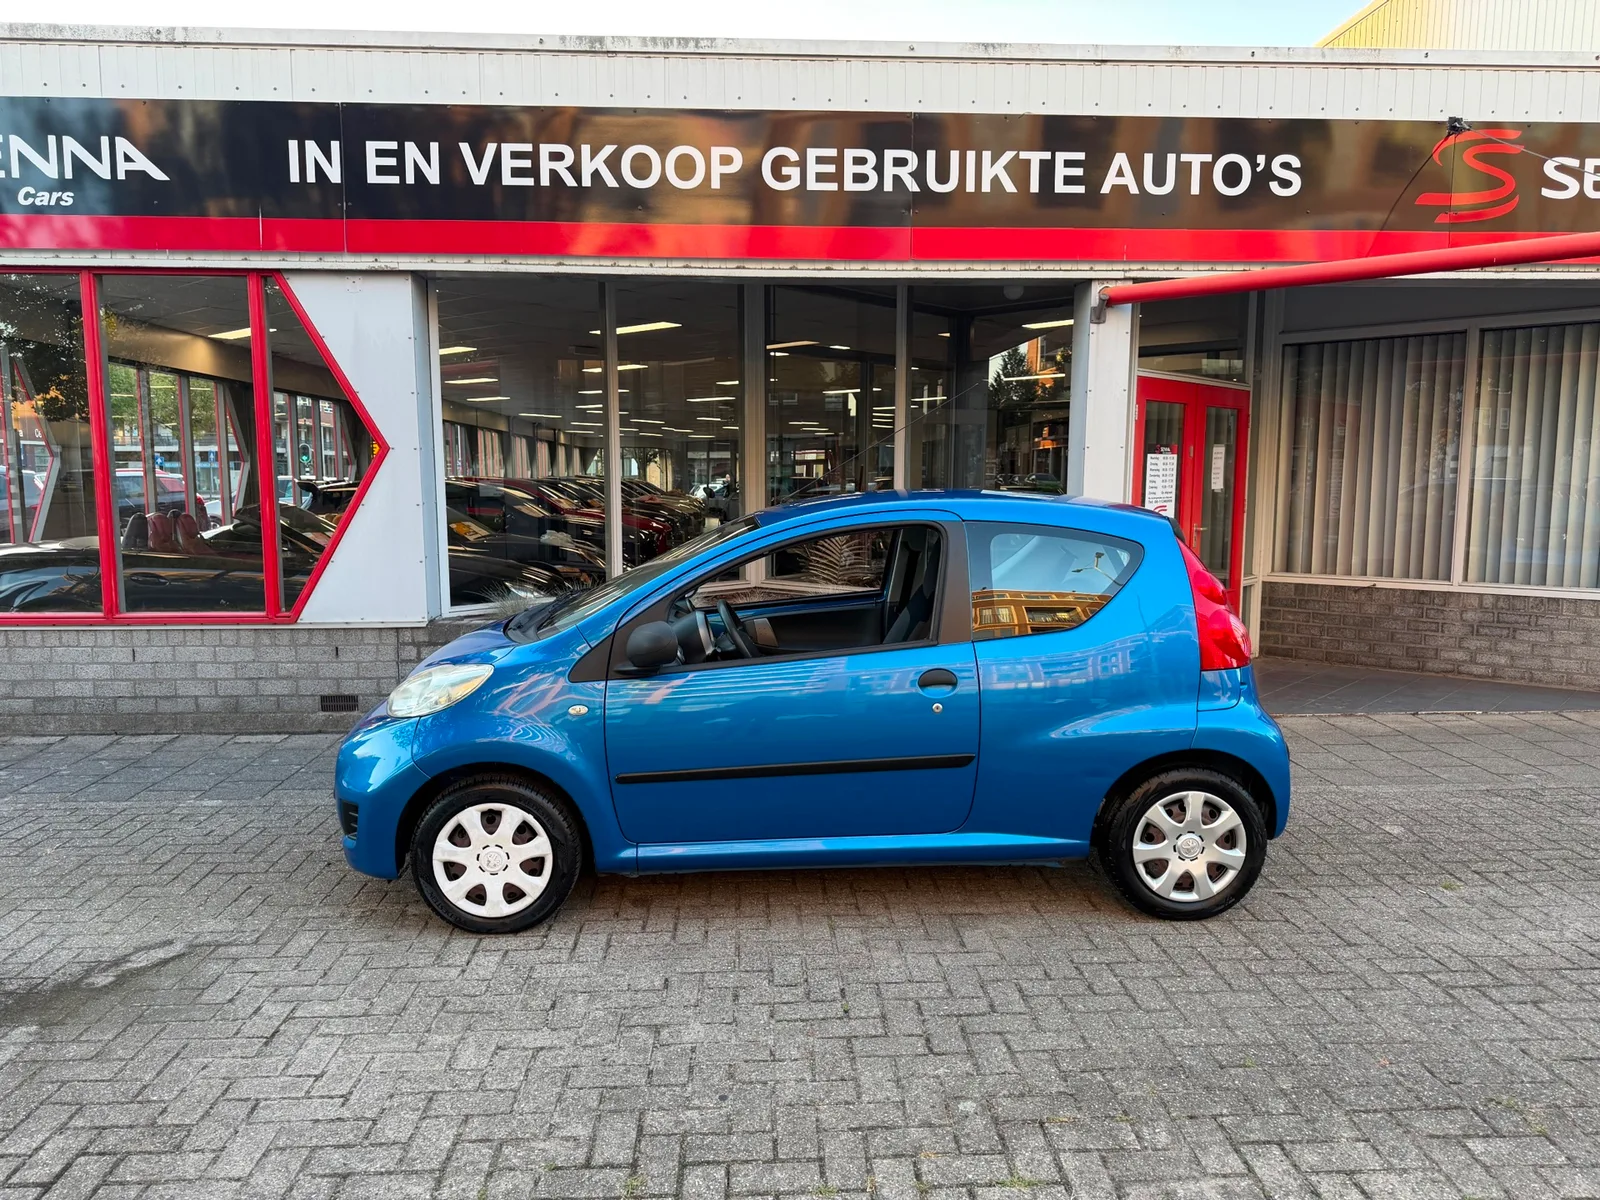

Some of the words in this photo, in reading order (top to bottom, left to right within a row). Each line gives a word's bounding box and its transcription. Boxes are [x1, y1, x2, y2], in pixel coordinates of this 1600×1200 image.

[0, 134, 171, 181] NNA
[288, 139, 342, 184] IN
[365, 140, 441, 185] EN
[458, 142, 744, 191] VERKOOP
[761, 146, 1086, 194] GEBRUIKTE
[1099, 152, 1303, 197] AUTO'S
[17, 186, 75, 206] Cars
